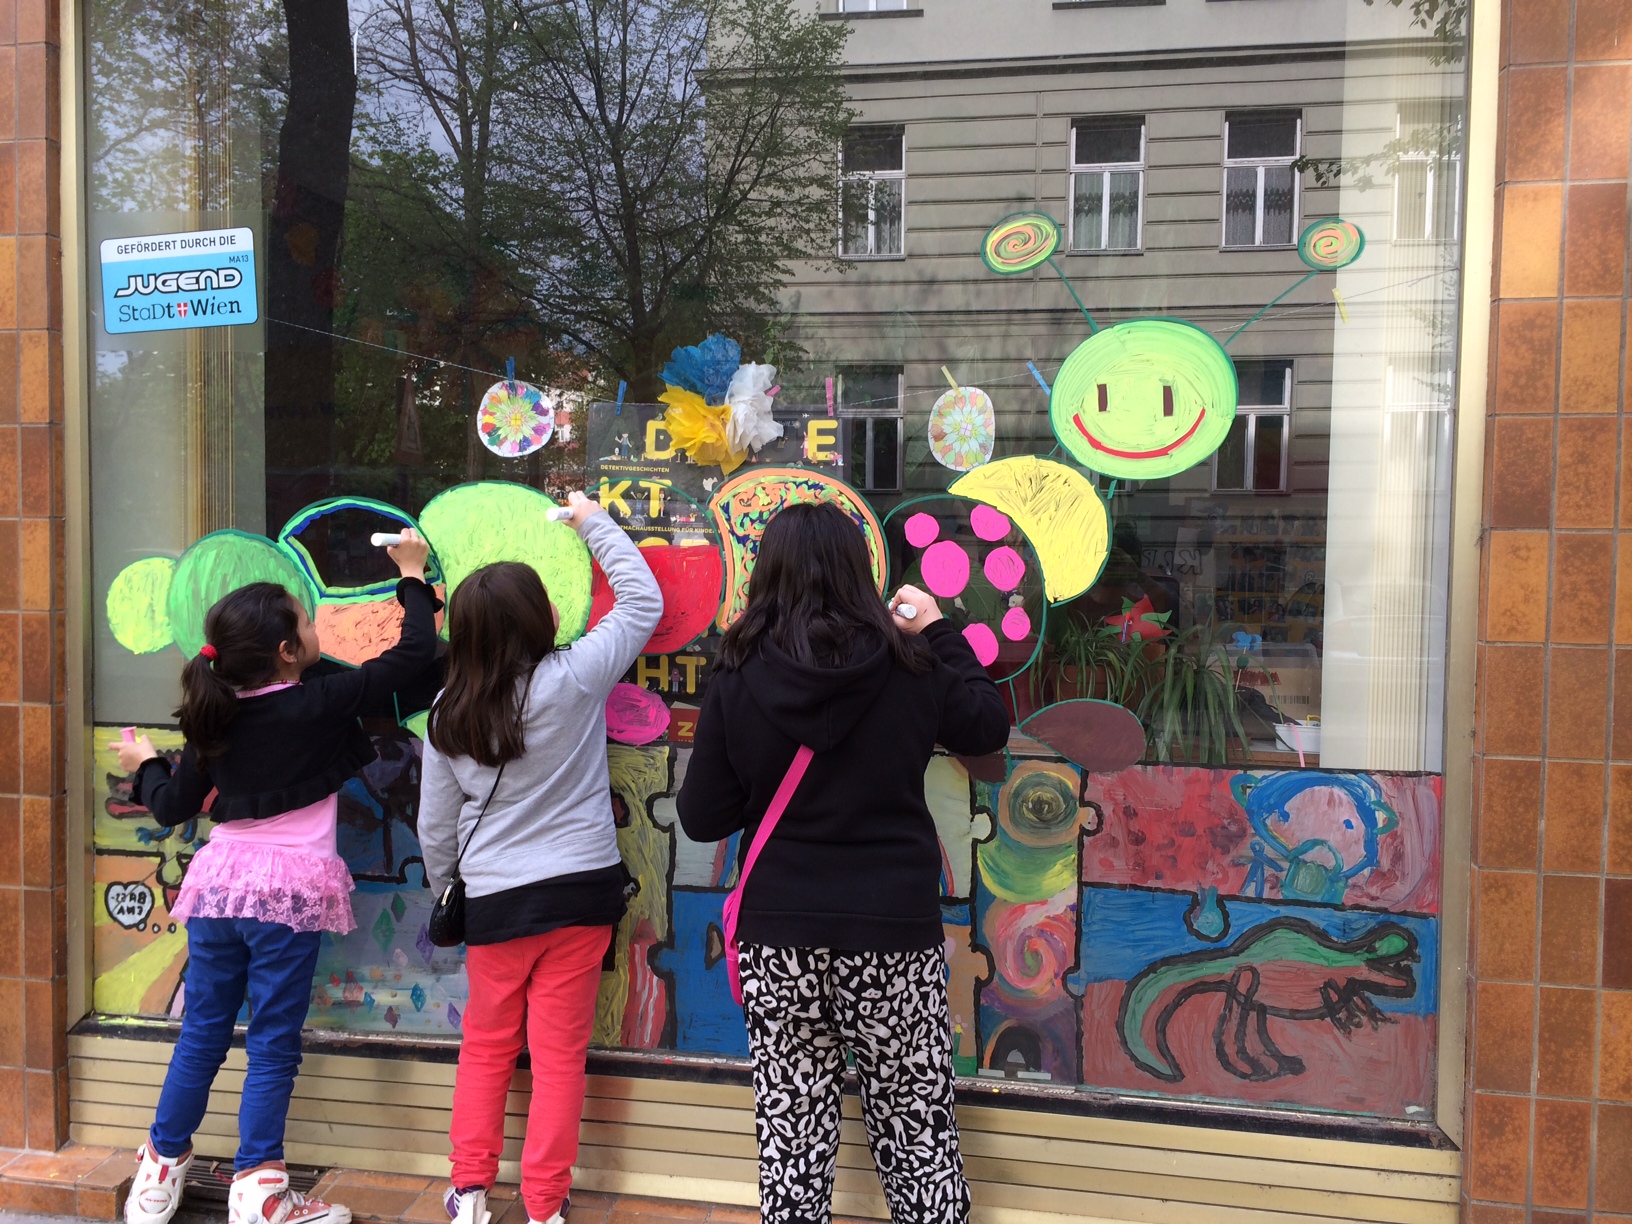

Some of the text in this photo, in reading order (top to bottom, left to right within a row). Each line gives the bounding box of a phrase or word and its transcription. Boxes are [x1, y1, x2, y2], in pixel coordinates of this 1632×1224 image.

[117, 235, 236, 255] GEFÖRDERT DURCH DIE
[228, 255, 249, 264] MA13
[113, 267, 243, 298] JUGEND
[190, 296, 241, 317] Wien
[600, 464, 670, 473] DETEKTIVGESCHICHTEN
